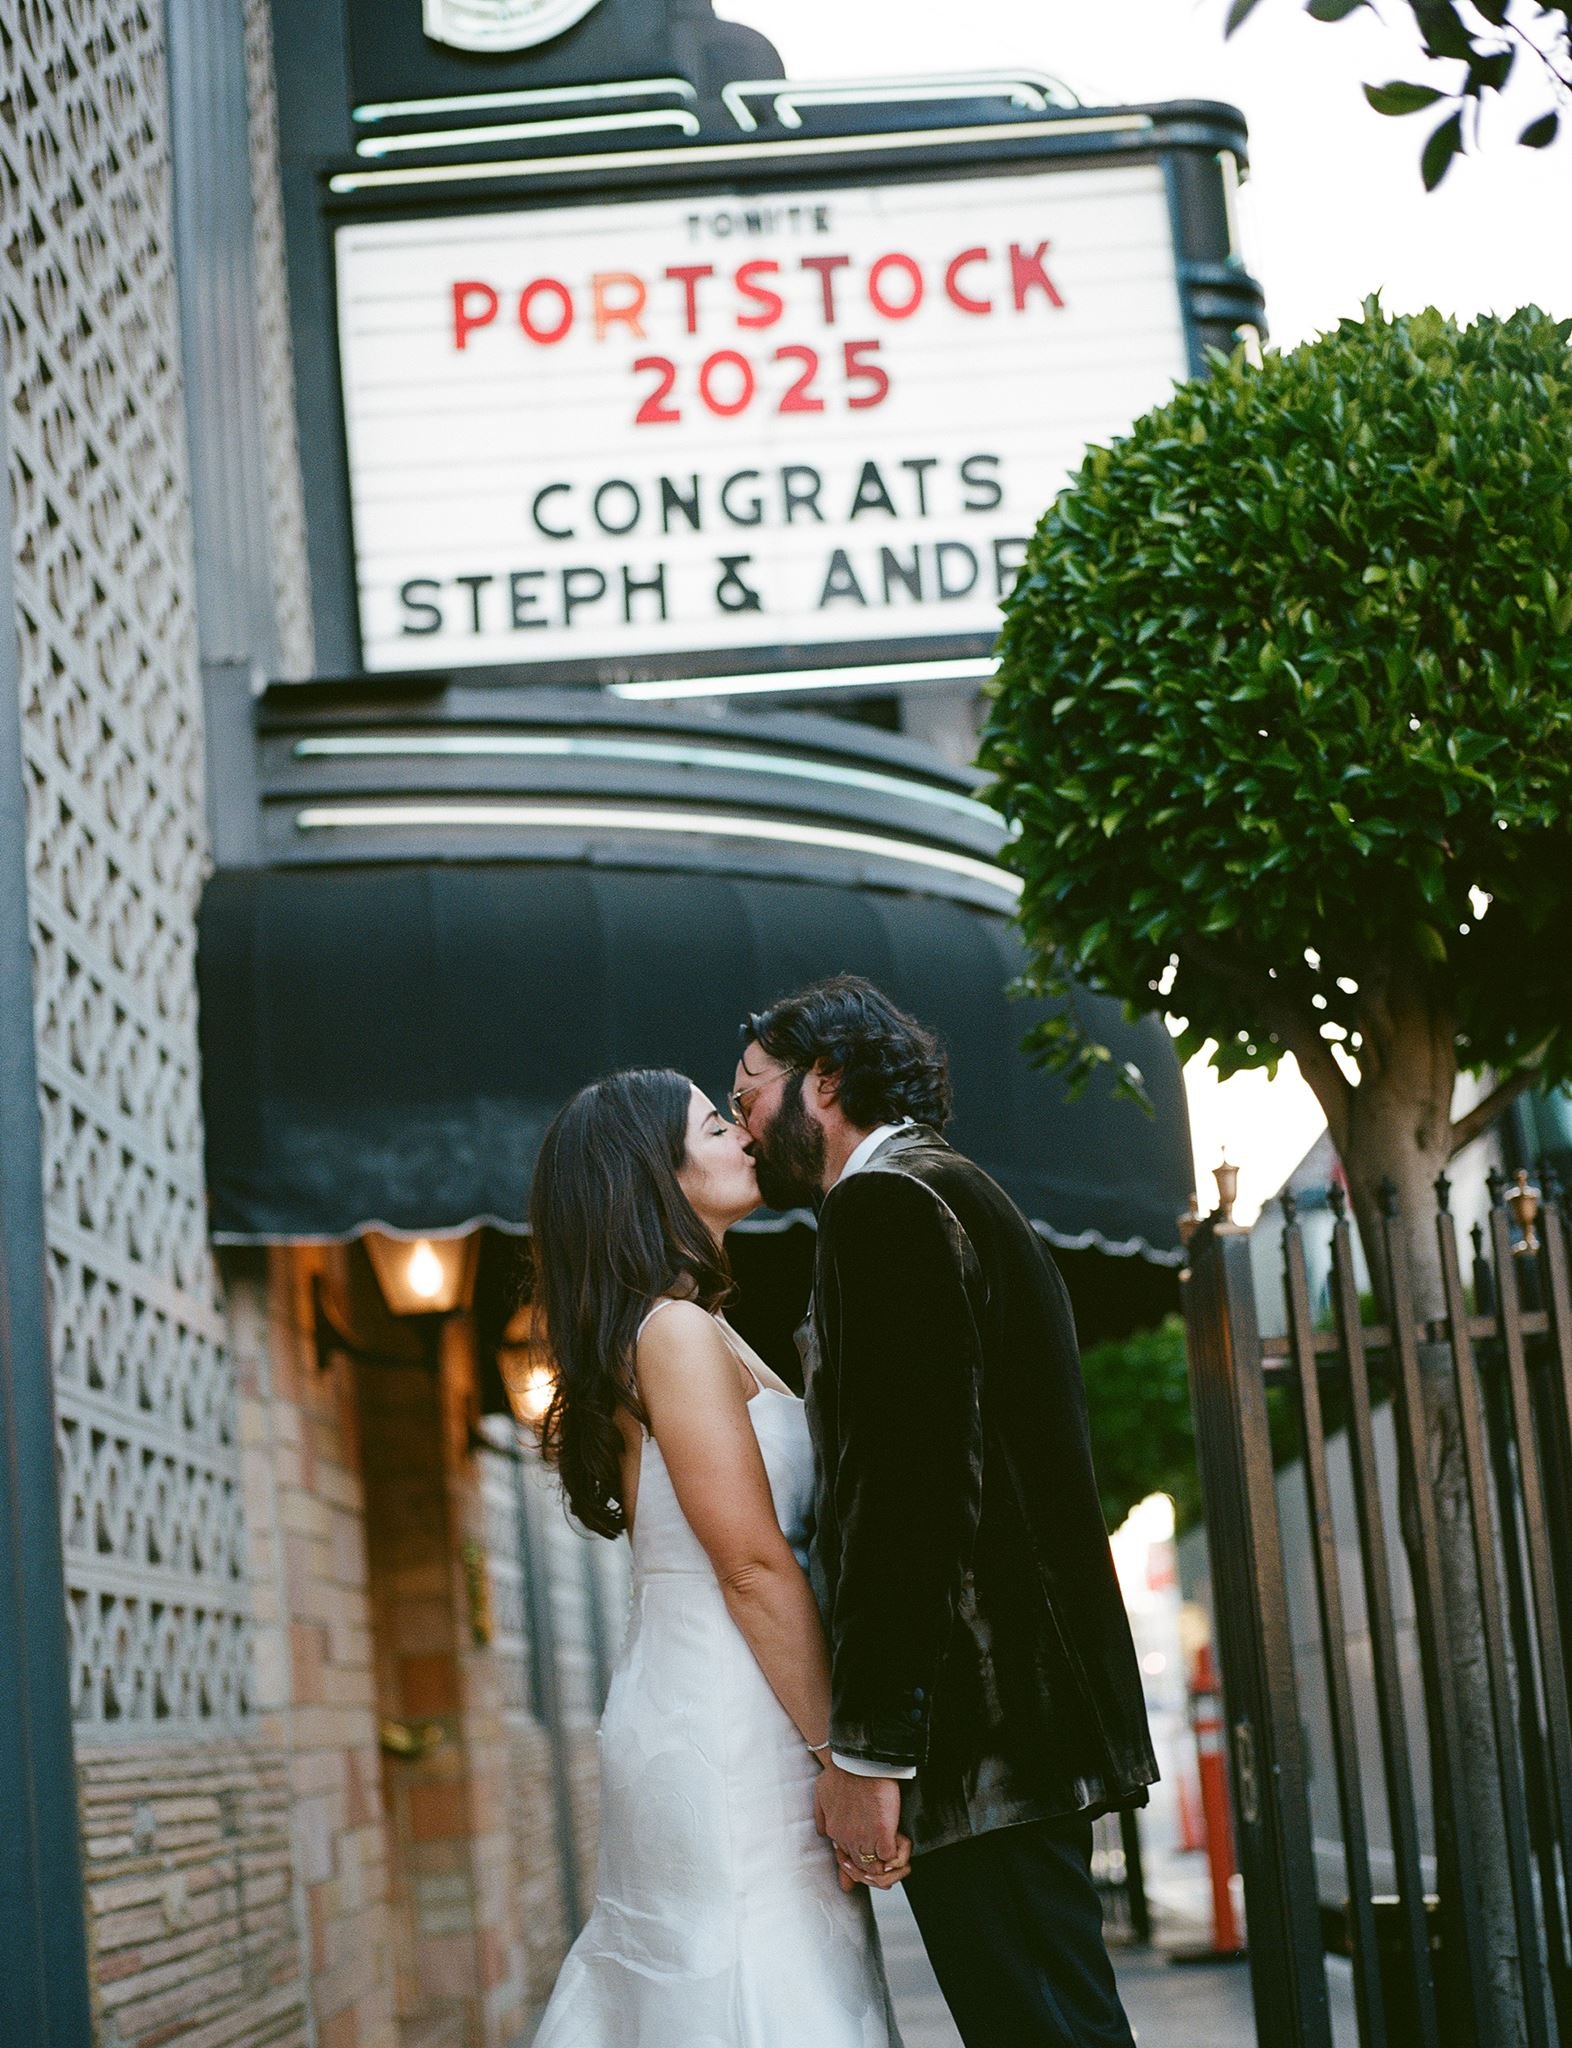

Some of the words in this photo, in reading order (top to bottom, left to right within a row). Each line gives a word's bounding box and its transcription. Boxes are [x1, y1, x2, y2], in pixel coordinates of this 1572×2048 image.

[686, 205, 829, 240] TONITE
[450, 240, 1065, 350] PORTSTOCK
[631, 339, 891, 425] 2025
[531, 453, 1002, 540] CONGRATS
[399, 562, 667, 637] STEPH
[715, 554, 763, 613] &
